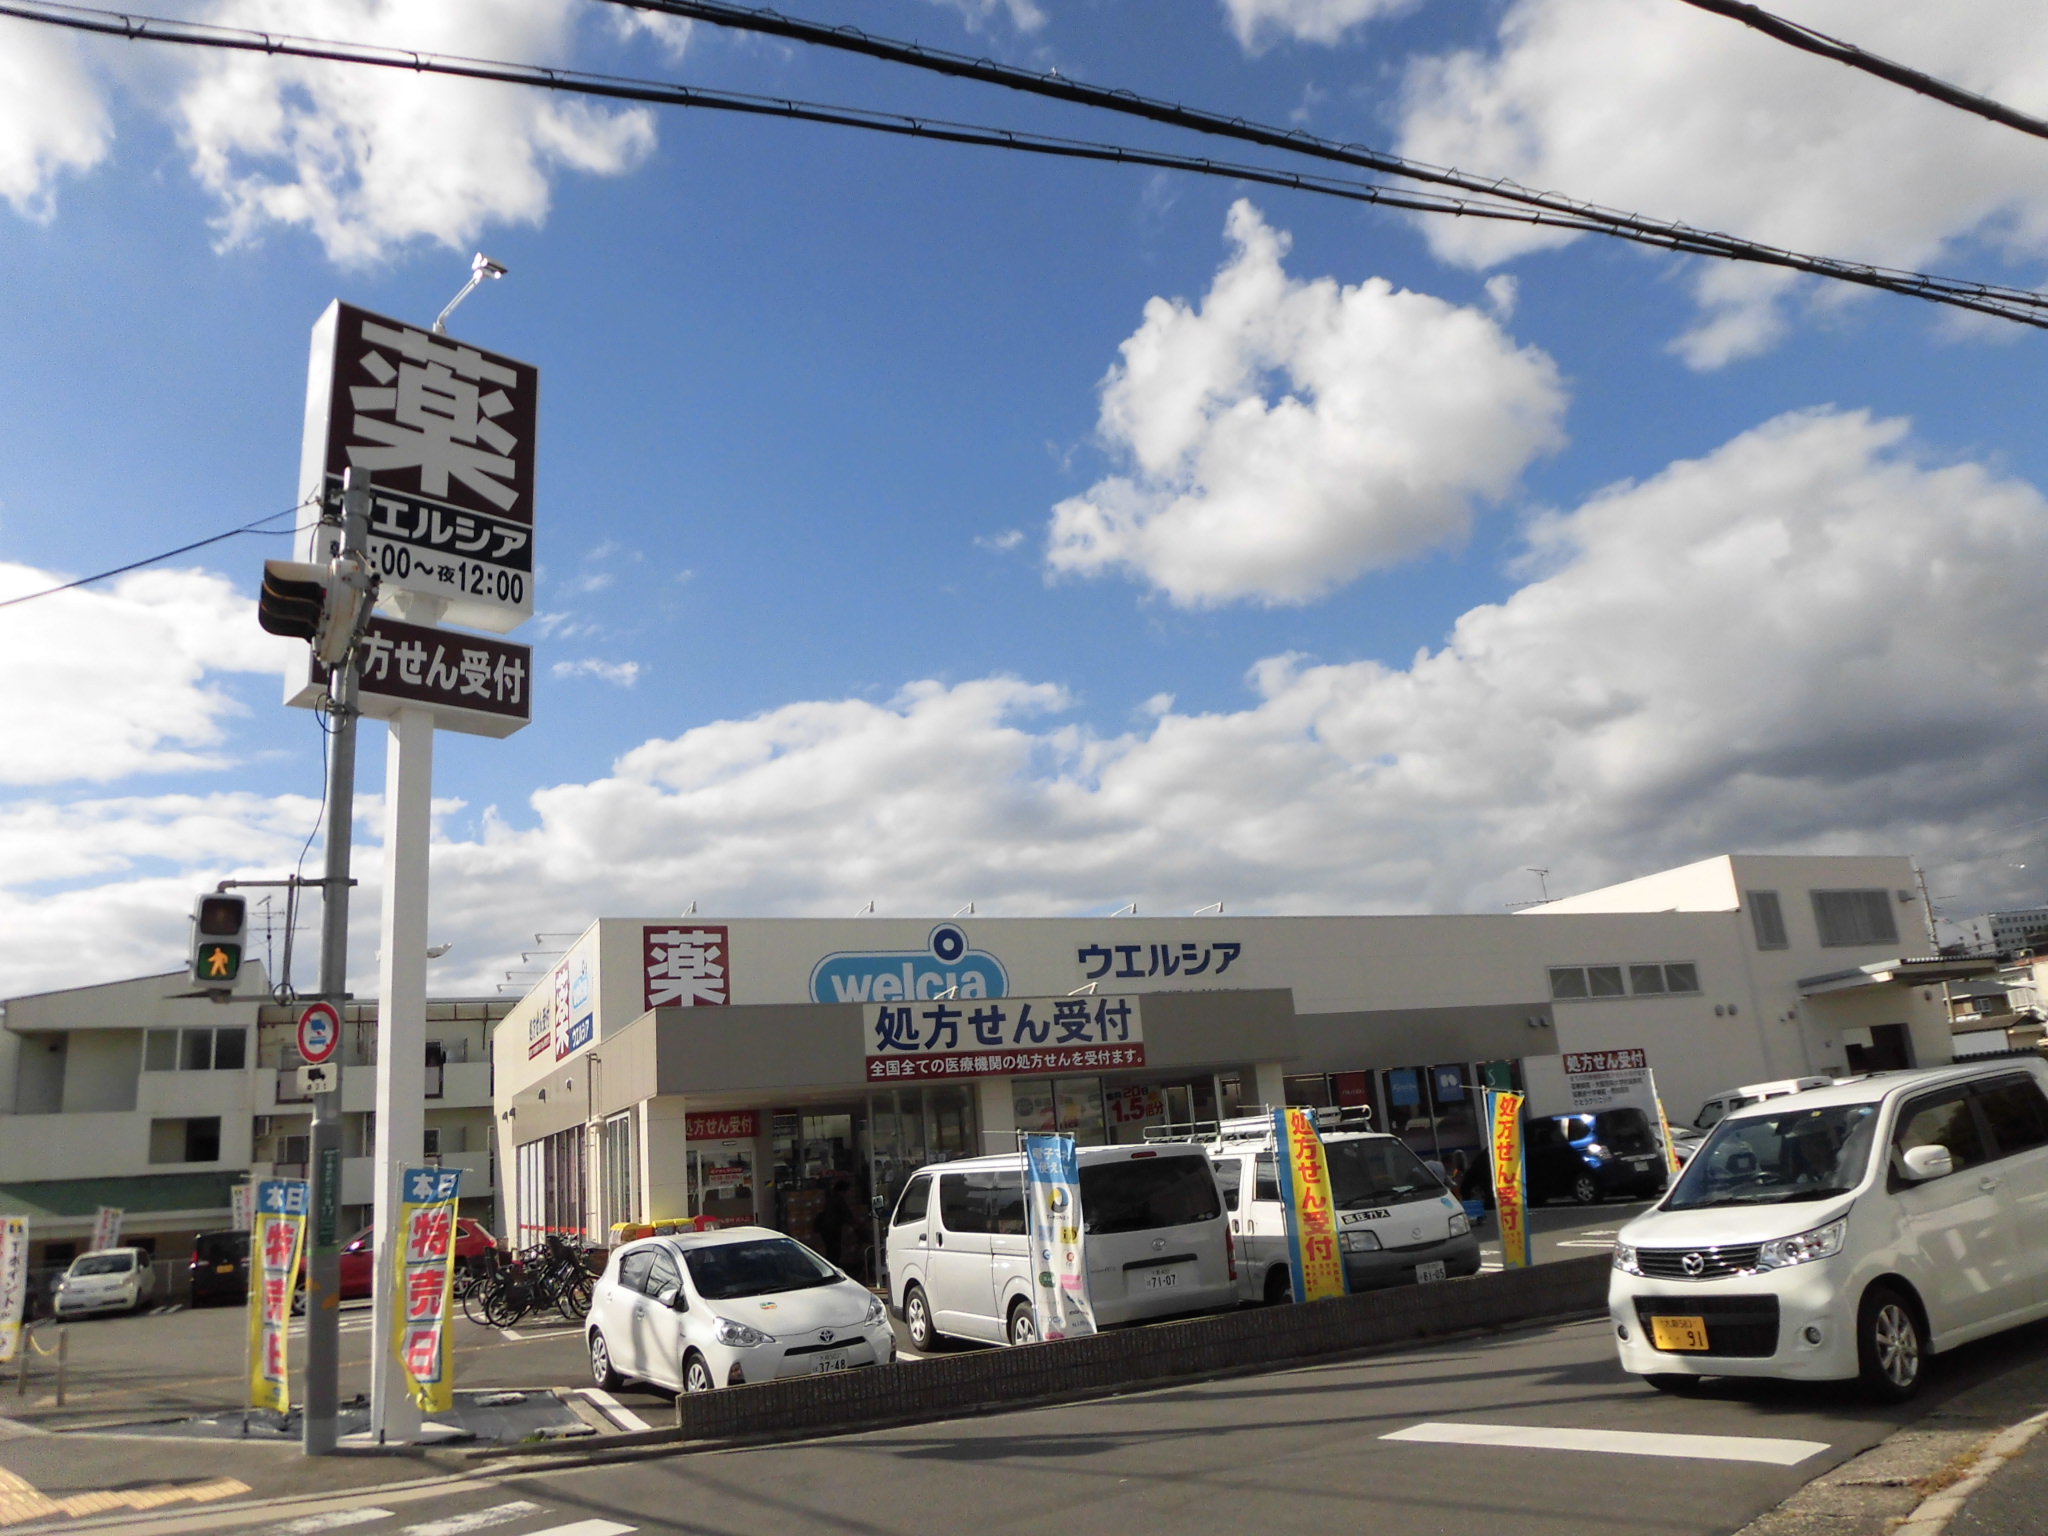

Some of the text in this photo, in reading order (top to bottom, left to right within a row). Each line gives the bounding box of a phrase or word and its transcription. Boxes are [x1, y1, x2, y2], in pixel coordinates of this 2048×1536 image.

[344, 320, 520, 512] 薬
[330, 488, 528, 559] エルシア
[331, 540, 523, 605] :00～夜12:00
[356, 629, 526, 704] 方せん受付
[647, 929, 727, 1007] 薬
[830, 960, 988, 1003] welcia
[1077, 942, 1242, 980] ウエルシア
[875, 998, 1133, 1052] 処方せん受付
[869, 1048, 1145, 1079] 全国全ての医療機関の処方せんを受付ます。
[1566, 1049, 1645, 1073] 処方せん受付
[412, 1172, 456, 1200] 本日
[1290, 1110, 1335, 1262] 処方せん受付
[1496, 1095, 1520, 1232] 処方せん受付
[266, 1186, 304, 1212] 本日
[407, 1212, 450, 1377] 特売日
